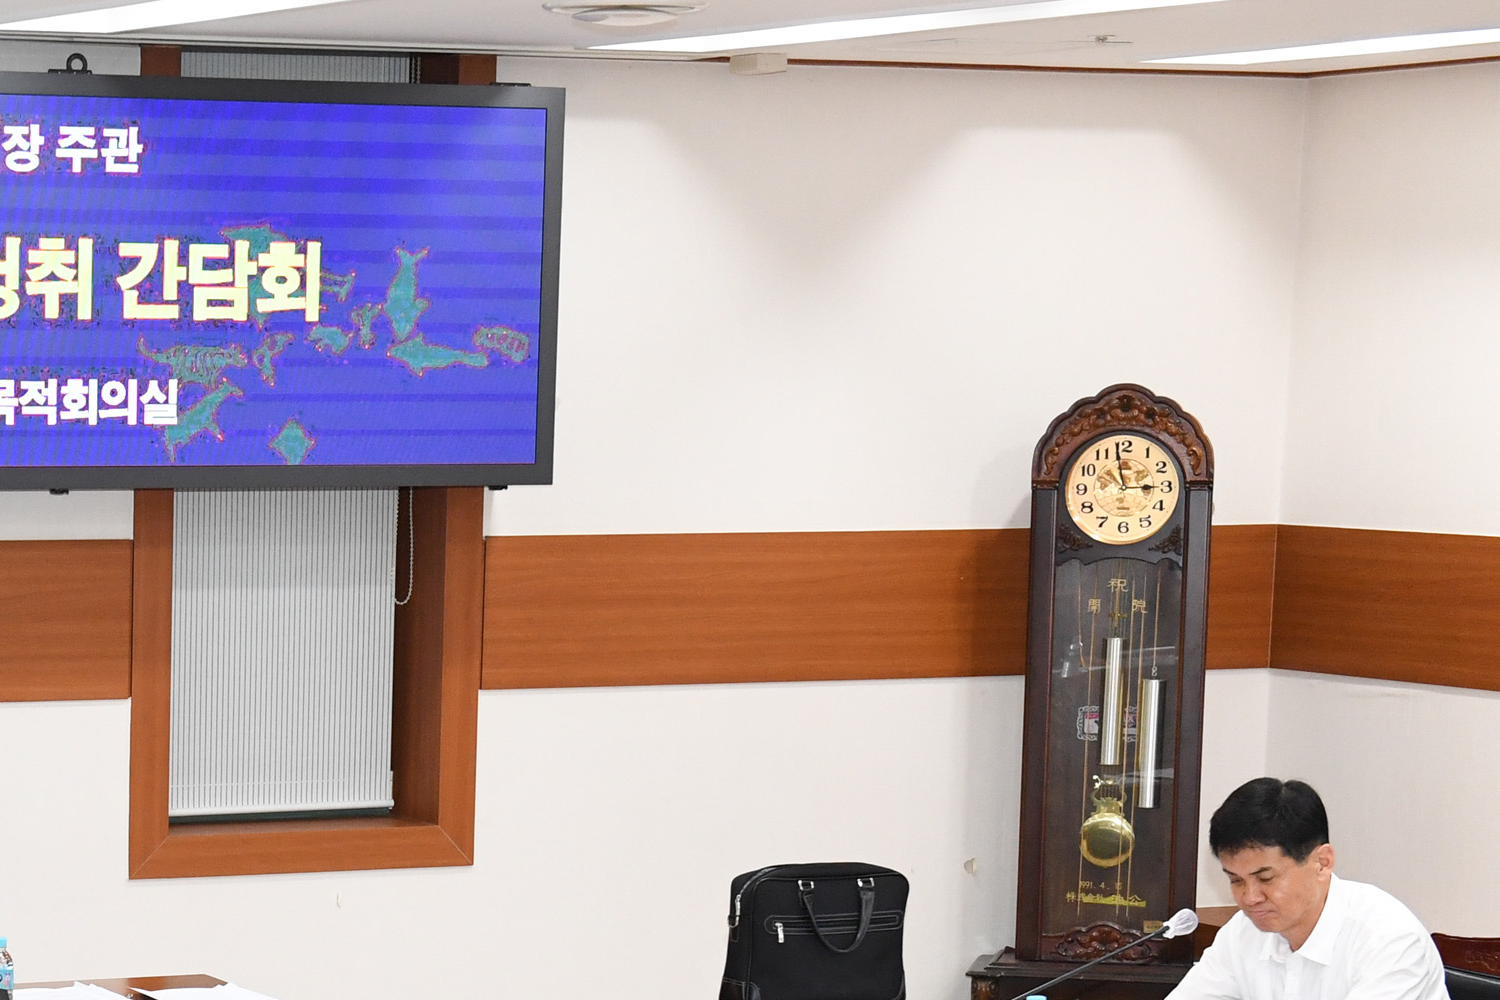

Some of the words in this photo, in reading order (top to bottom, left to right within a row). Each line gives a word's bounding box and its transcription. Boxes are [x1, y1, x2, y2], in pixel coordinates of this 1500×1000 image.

[55, 125, 144, 173] 주관
[116, 239, 322, 322] 간담회
[1095, 447, 1109, 461] 11
[1145, 446, 1151, 459] 1
[1081, 463, 1096, 477] 10
[1155, 461, 1167, 474] 2
[1076, 483, 1088, 495] 9
[1160, 480, 1173, 493] 3
[1080, 501, 1094, 514] 8
[1152, 500, 1165, 511] 4
[1096, 516, 1108, 528] 7
[1117, 521, 1129, 533] 6
[1139, 515, 1152, 528] 5
